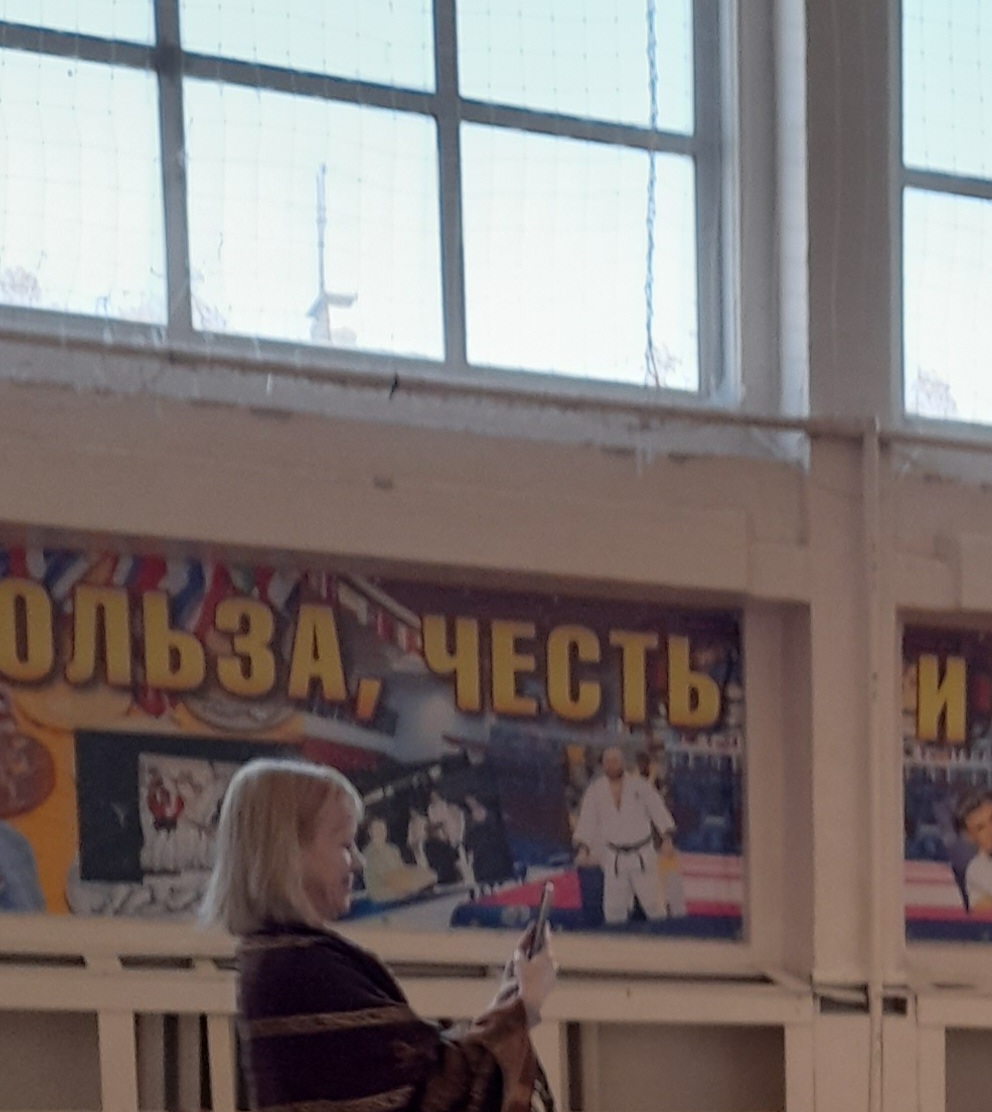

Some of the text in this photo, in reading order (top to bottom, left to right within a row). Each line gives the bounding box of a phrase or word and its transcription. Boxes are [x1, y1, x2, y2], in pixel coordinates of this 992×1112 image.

[0, 578, 381, 720] ОЛЬЗА,
[421, 613, 724, 728] ЧЕСТЬ
[915, 653, 968, 744] И
